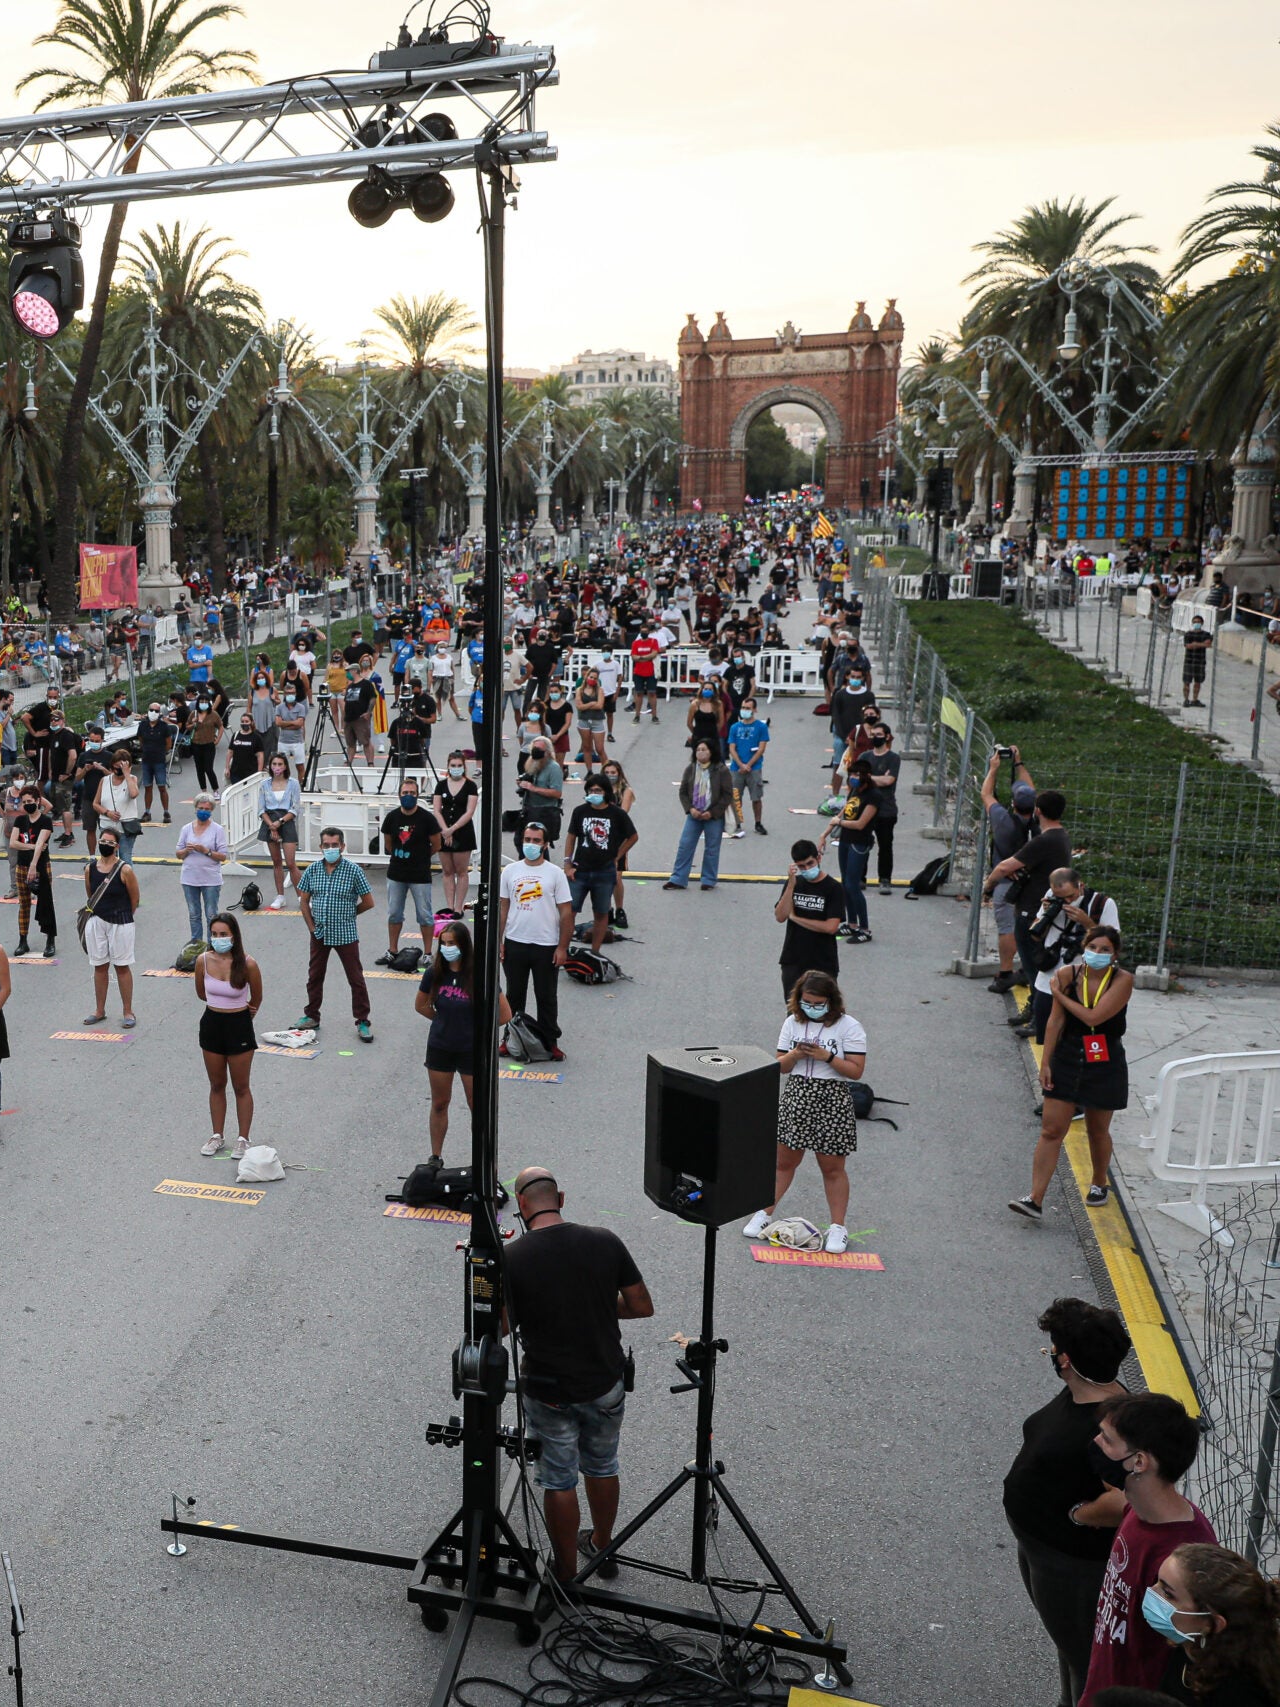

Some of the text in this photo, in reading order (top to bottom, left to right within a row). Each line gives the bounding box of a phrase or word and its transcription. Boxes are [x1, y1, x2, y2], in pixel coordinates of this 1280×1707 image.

[49, 1031, 126, 1042] FEMINISME
[157, 1183, 264, 1201] PAÏSOS CATALANS
[383, 1204, 472, 1223] FEMINISM
